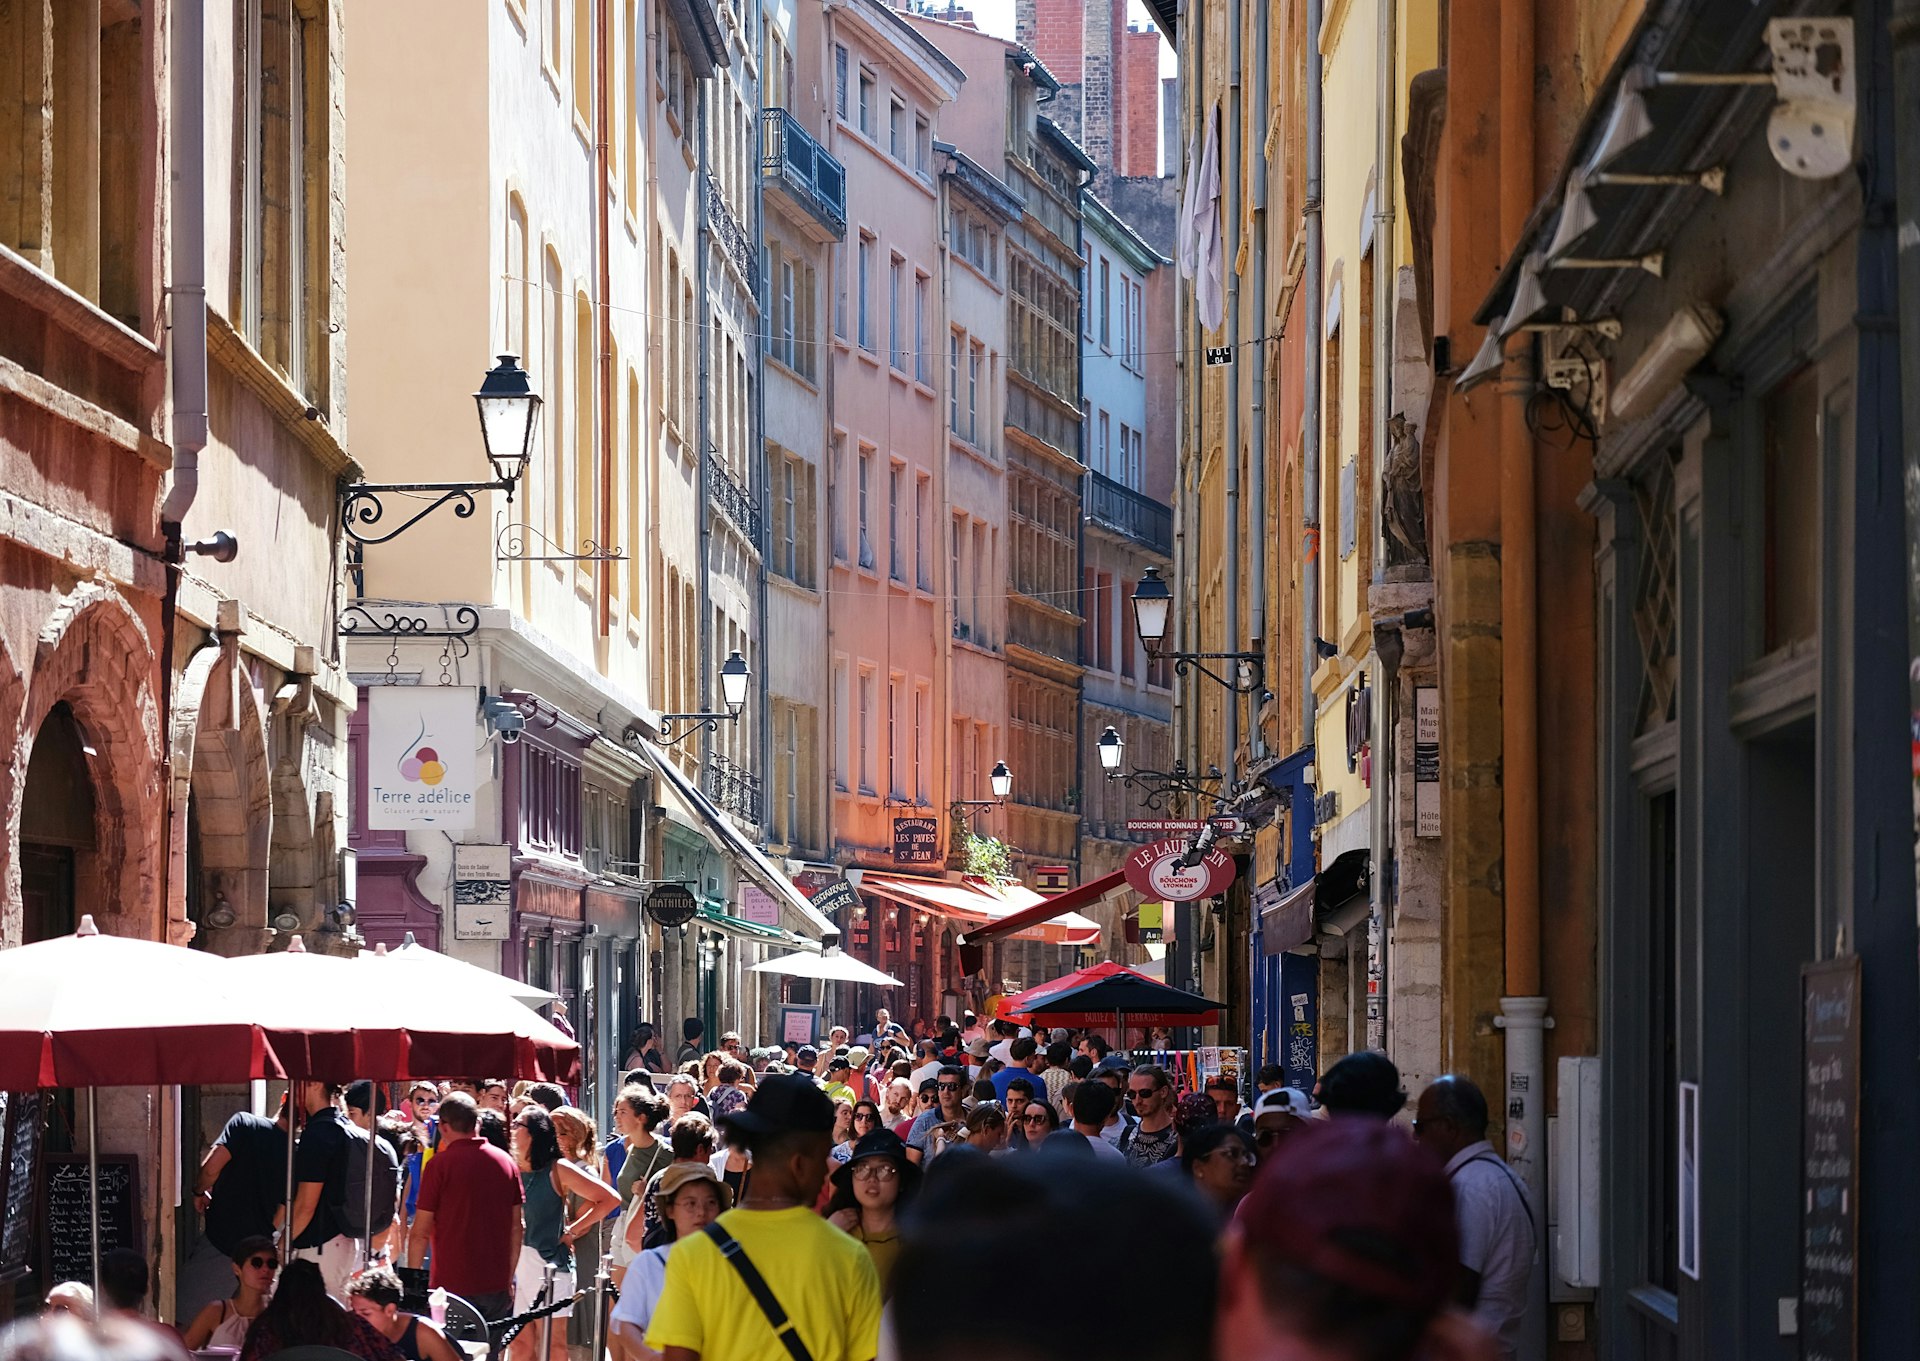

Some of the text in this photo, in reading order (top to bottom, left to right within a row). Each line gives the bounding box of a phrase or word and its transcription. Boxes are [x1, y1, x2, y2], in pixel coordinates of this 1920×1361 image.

[1420, 729, 1436, 738] Rue
[373, 787, 471, 803] Terre adélice
[895, 819, 935, 832] RESTAURANT
[1127, 821, 1162, 829] BOUCHON
[1164, 821, 1198, 829] LYONNAIS
[895, 834, 909, 843] LES
[911, 851, 930, 860] JEAN
[1133, 849, 1153, 868] LE
[649, 898, 694, 908] MATHILDE
